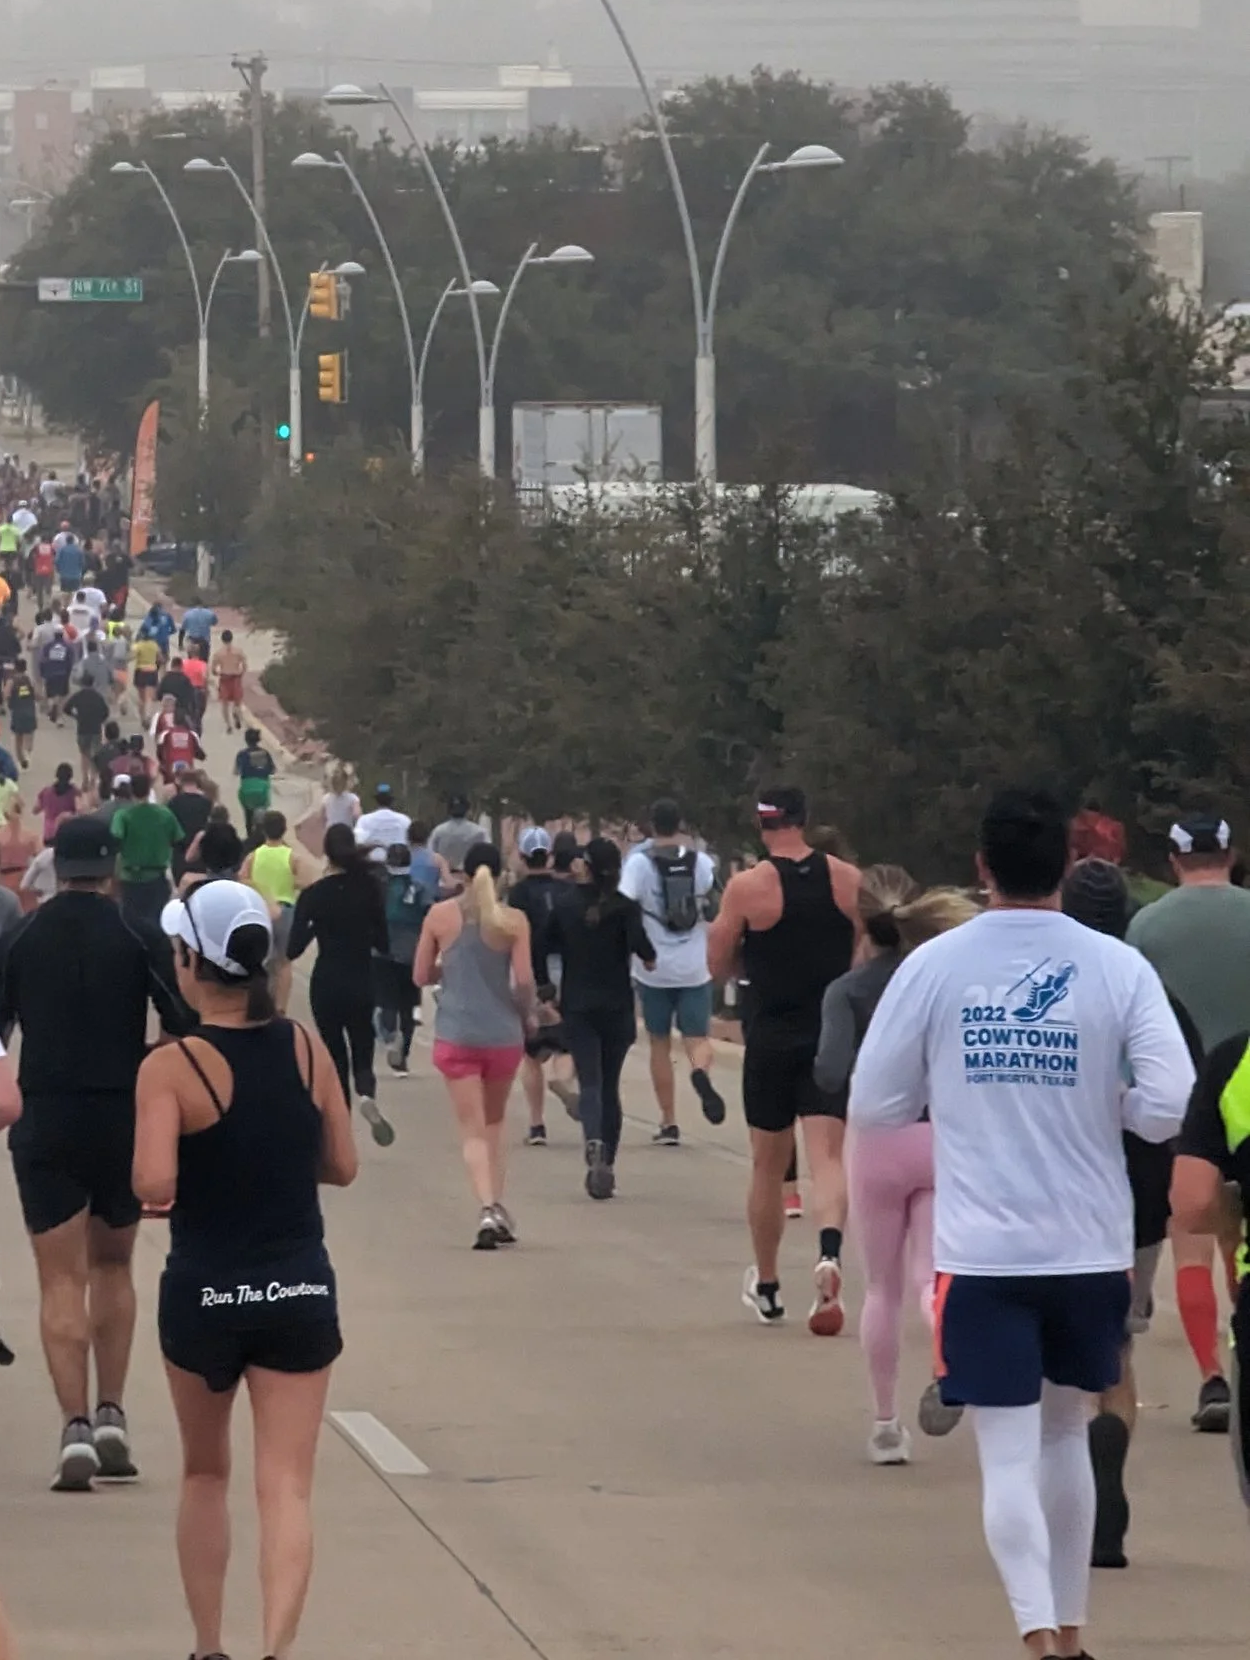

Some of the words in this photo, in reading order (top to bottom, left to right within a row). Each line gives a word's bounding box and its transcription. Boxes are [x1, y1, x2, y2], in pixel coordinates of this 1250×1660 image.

[961, 1006, 1007, 1023] 2022
[963, 1028, 1078, 1050] COWTOWN
[964, 1052, 1078, 1072] MARATHON
[201, 1286, 234, 1307] Run
[236, 1284, 265, 1305] The
[266, 1281, 330, 1302] Cowtown
